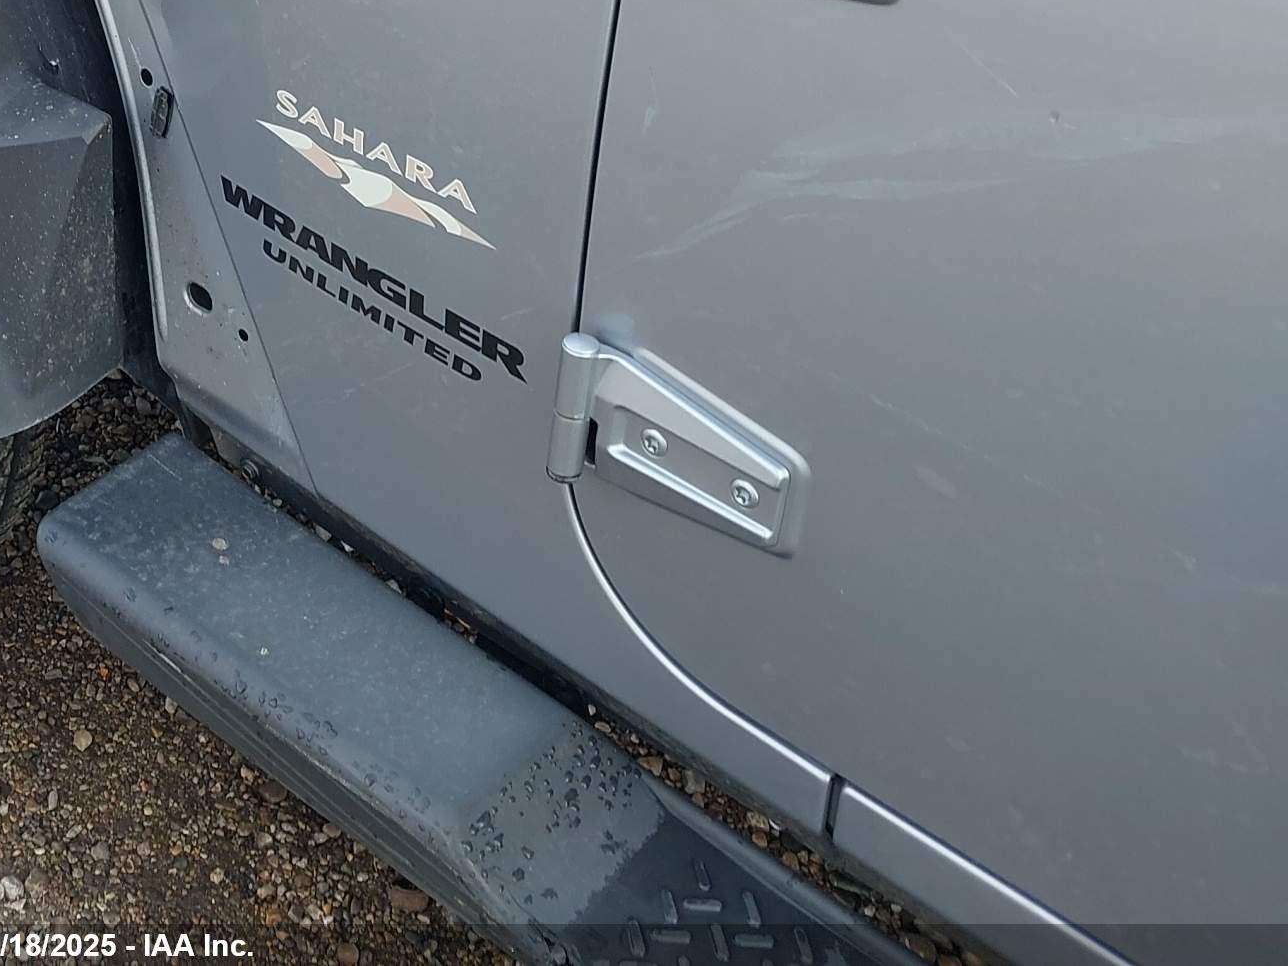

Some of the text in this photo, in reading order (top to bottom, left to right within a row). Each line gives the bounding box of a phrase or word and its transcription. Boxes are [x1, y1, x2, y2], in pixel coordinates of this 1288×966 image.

[275, 89, 478, 215] SAHARA
[220, 175, 528, 384] WRANGLER
[262, 238, 482, 382] UNLIMITED
